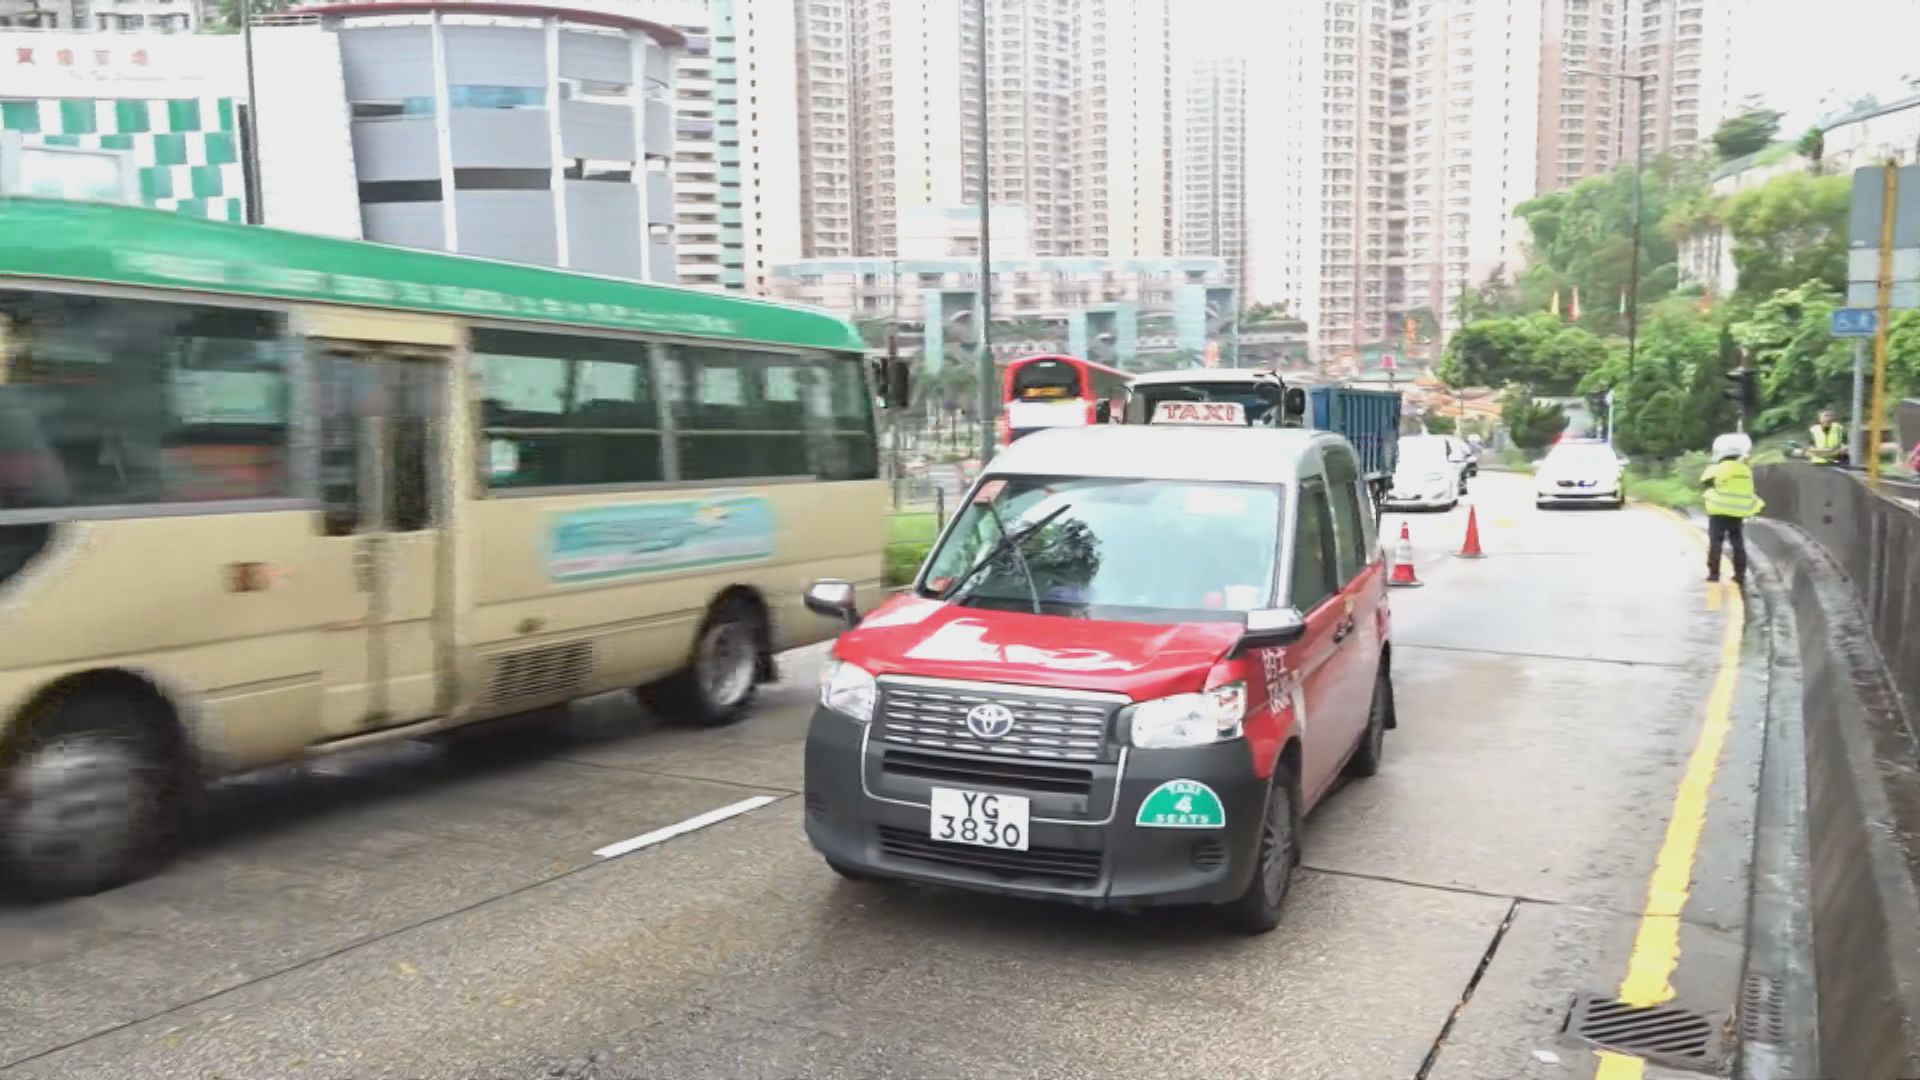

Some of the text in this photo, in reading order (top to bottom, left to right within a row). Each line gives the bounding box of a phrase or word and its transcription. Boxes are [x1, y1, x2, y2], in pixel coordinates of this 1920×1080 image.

[1161, 403, 1236, 421] TAXI
[962, 792, 999, 819] YG
[1174, 794, 1193, 813] 4
[1154, 814, 1209, 824] SEATS
[940, 815, 1020, 847] 3830
